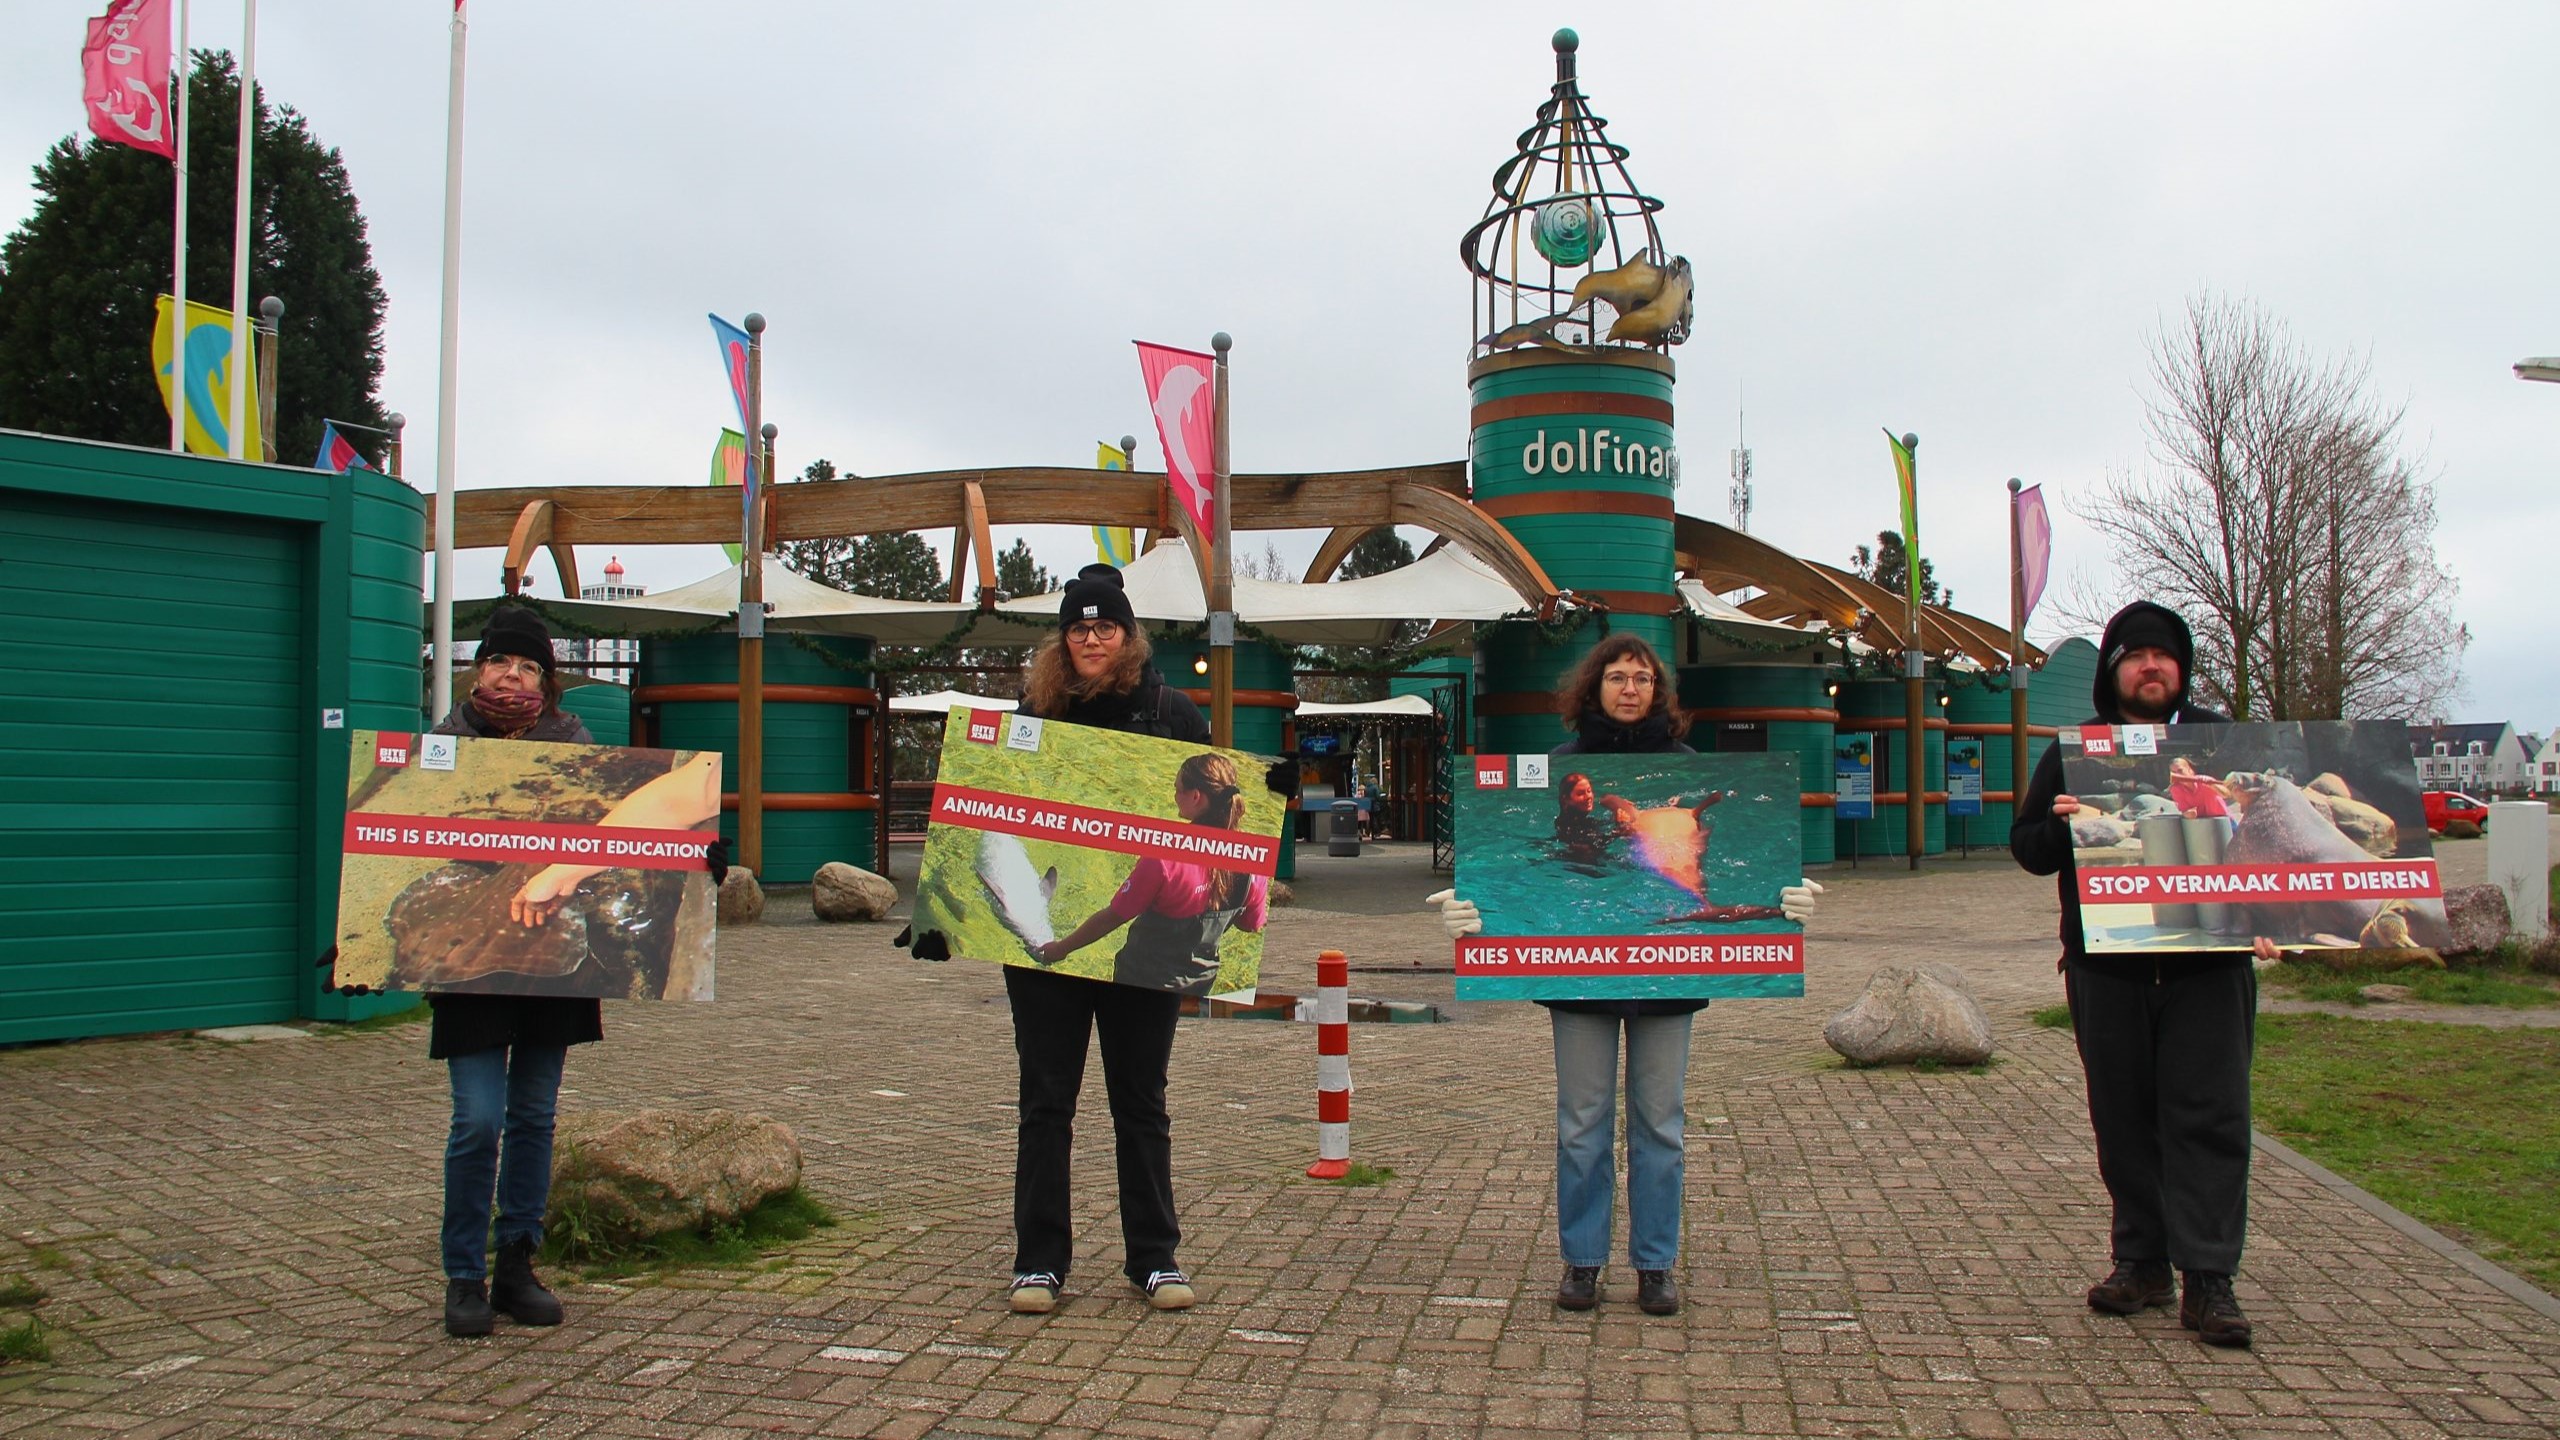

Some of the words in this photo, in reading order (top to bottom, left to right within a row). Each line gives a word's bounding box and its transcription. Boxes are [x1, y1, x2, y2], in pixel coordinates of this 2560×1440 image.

[971, 724, 996, 735] BITE
[2086, 739, 2110, 747] BITE
[380, 747, 406, 757] BITE
[1479, 770, 1503, 779] BITE
[942, 796, 1027, 824] ANIMALS
[1031, 811, 1067, 830] ARE
[1072, 818, 1114, 838] NOT
[1118, 825, 1269, 864] ENTERTAINMENT
[356, 826, 397, 843] THIS
[402, 828, 419, 845] IS
[425, 830, 556, 851] EXPLOITATION
[561, 837, 602, 854] NOT
[606, 840, 709, 859] EDUCATION
[2088, 876, 2151, 895] STOP
[2156, 873, 2281, 894] VERMAAK
[2288, 872, 2335, 891] MET
[2342, 870, 2430, 890] DIEREN
[1464, 947, 1509, 965] KIES
[1514, 946, 1620, 964] VERMAAK
[1626, 946, 1714, 964] ZONDER
[1721, 945, 1794, 962] DIEREN
